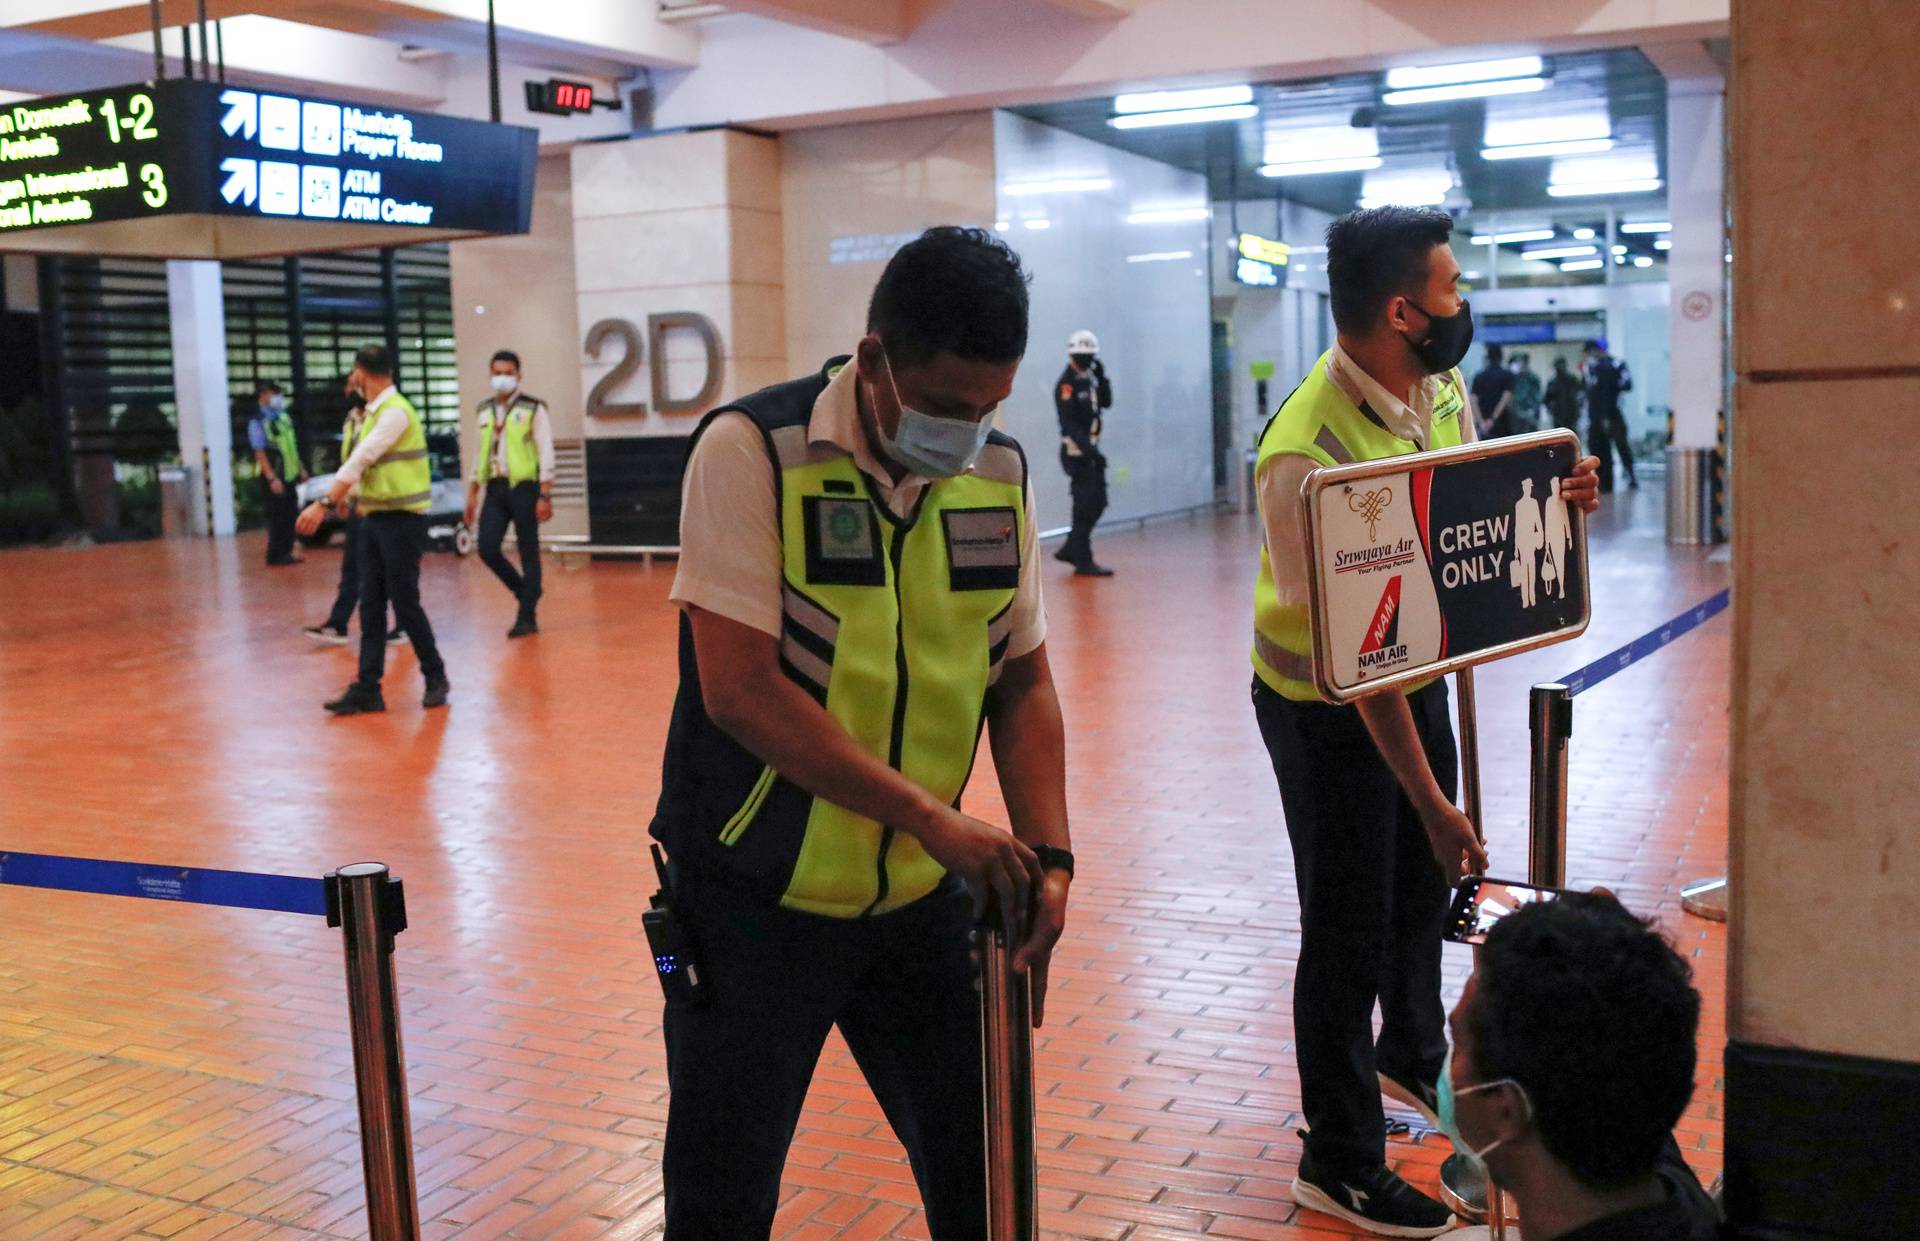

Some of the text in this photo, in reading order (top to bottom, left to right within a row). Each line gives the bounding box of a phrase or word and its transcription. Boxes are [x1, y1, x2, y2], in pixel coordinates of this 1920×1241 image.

[99, 94, 158, 143] 1-2
[343, 128, 443, 162] Prayer Room
[140, 163, 168, 208] 3
[343, 169, 381, 194] ATM
[342, 196, 433, 224] ATM Center
[585, 312, 725, 419] 2D
[1335, 537, 1414, 567] Sriwijaya Air
[1439, 514, 1509, 554] CREW
[1358, 558, 1415, 575] Your Flying Partner
[1442, 550, 1504, 589] ONLY
[1374, 594, 1395, 646] NAM
[1358, 644, 1408, 668] NAM AIR
